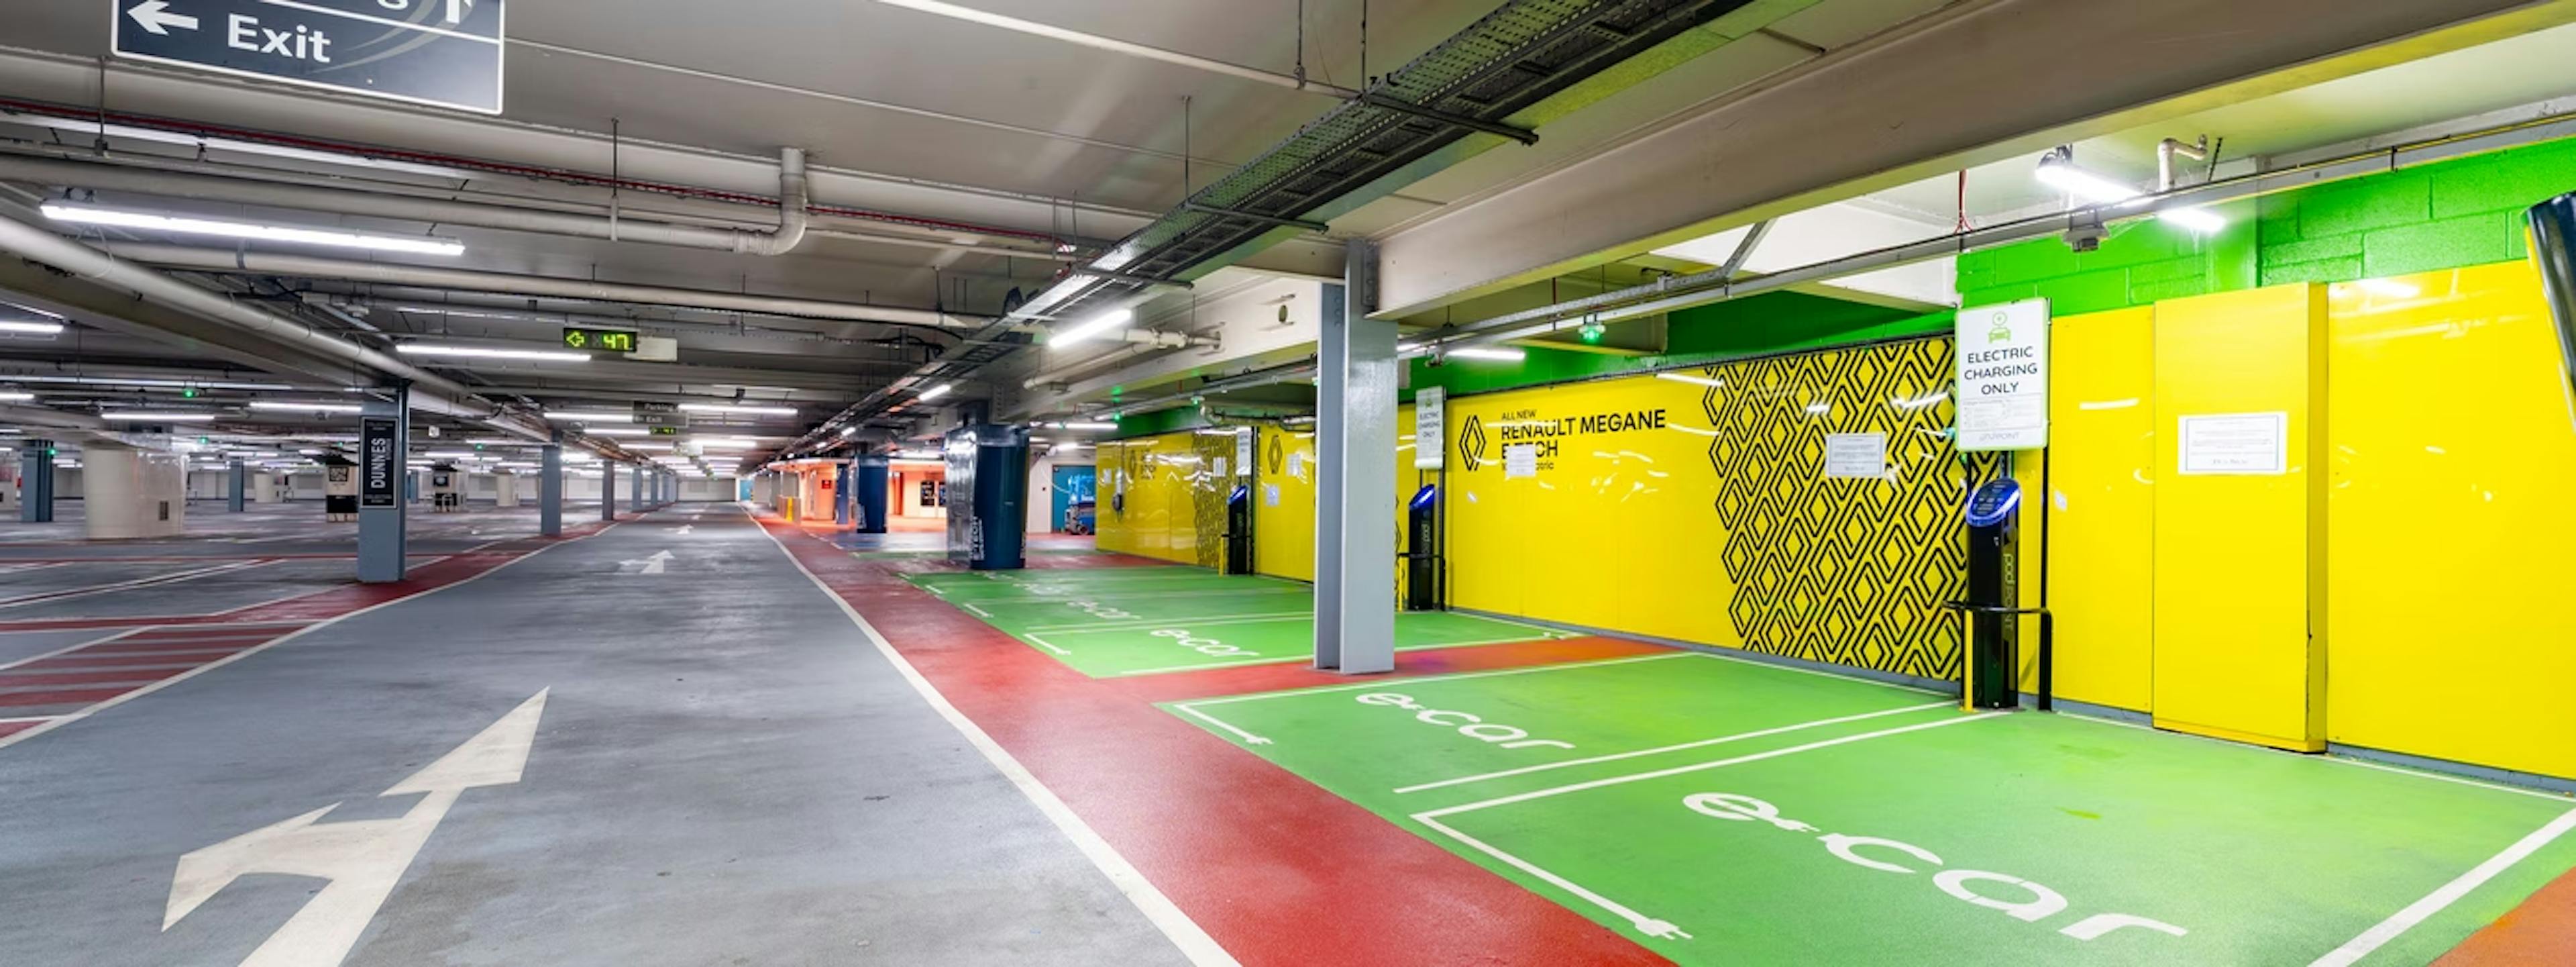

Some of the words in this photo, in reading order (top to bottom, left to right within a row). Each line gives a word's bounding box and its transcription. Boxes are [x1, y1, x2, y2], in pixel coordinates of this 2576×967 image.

[228, 13, 331, 63] Exit
[604, 334, 629, 350] 47
[1968, 346, 2033, 363] ELECTRIC
[1964, 362, 2037, 380] CHARGING
[1981, 382, 2019, 395] ONLY
[1502, 411, 1515, 421] ALL
[1516, 409, 1538, 419] NEW
[1501, 417, 1576, 440] RENAULT
[1580, 409, 1666, 434] MEGANE
[370, 438, 386, 489] DUNNES
